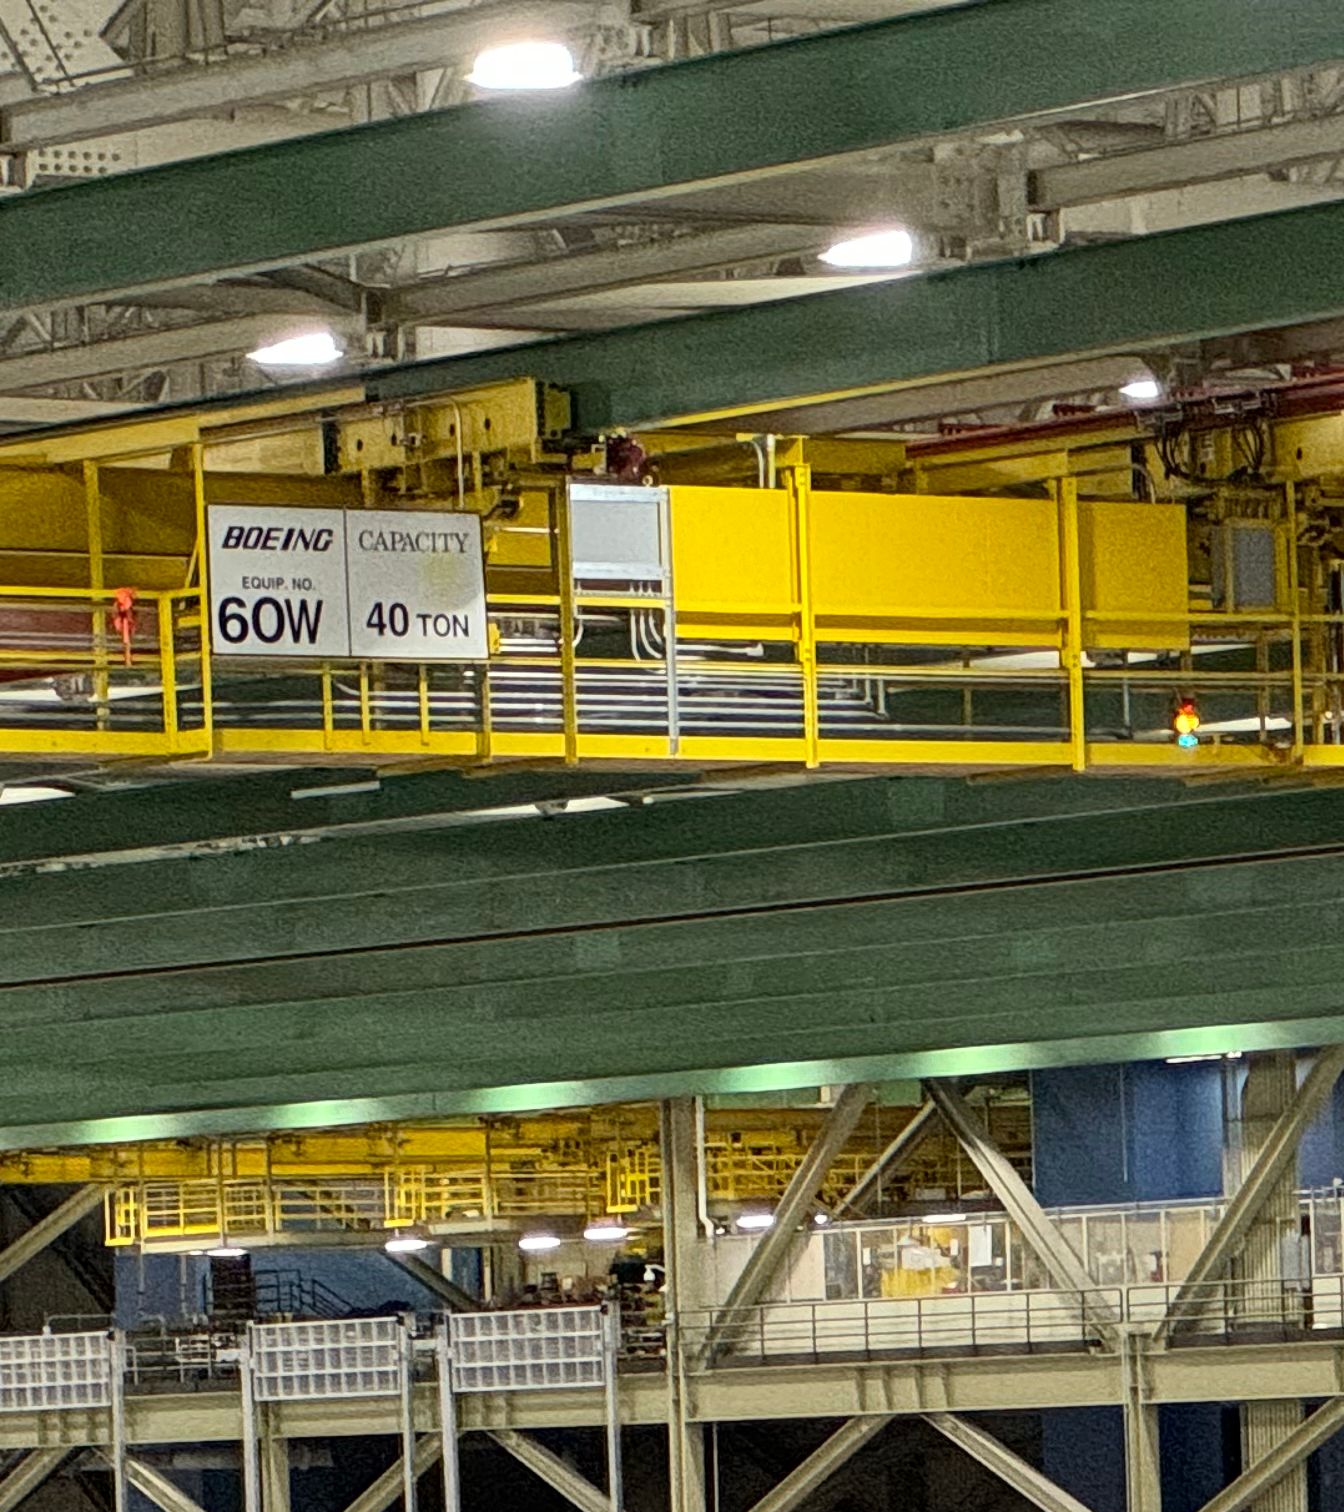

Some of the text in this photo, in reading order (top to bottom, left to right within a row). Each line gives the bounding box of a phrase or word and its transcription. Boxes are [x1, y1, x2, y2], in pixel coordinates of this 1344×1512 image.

[221, 526, 334, 552] BOEING
[358, 529, 469, 553] CAPACITY
[241, 576, 316, 591] EQUIP. NO.
[218, 596, 323, 644] 60W
[366, 601, 469, 637] 40 TON
